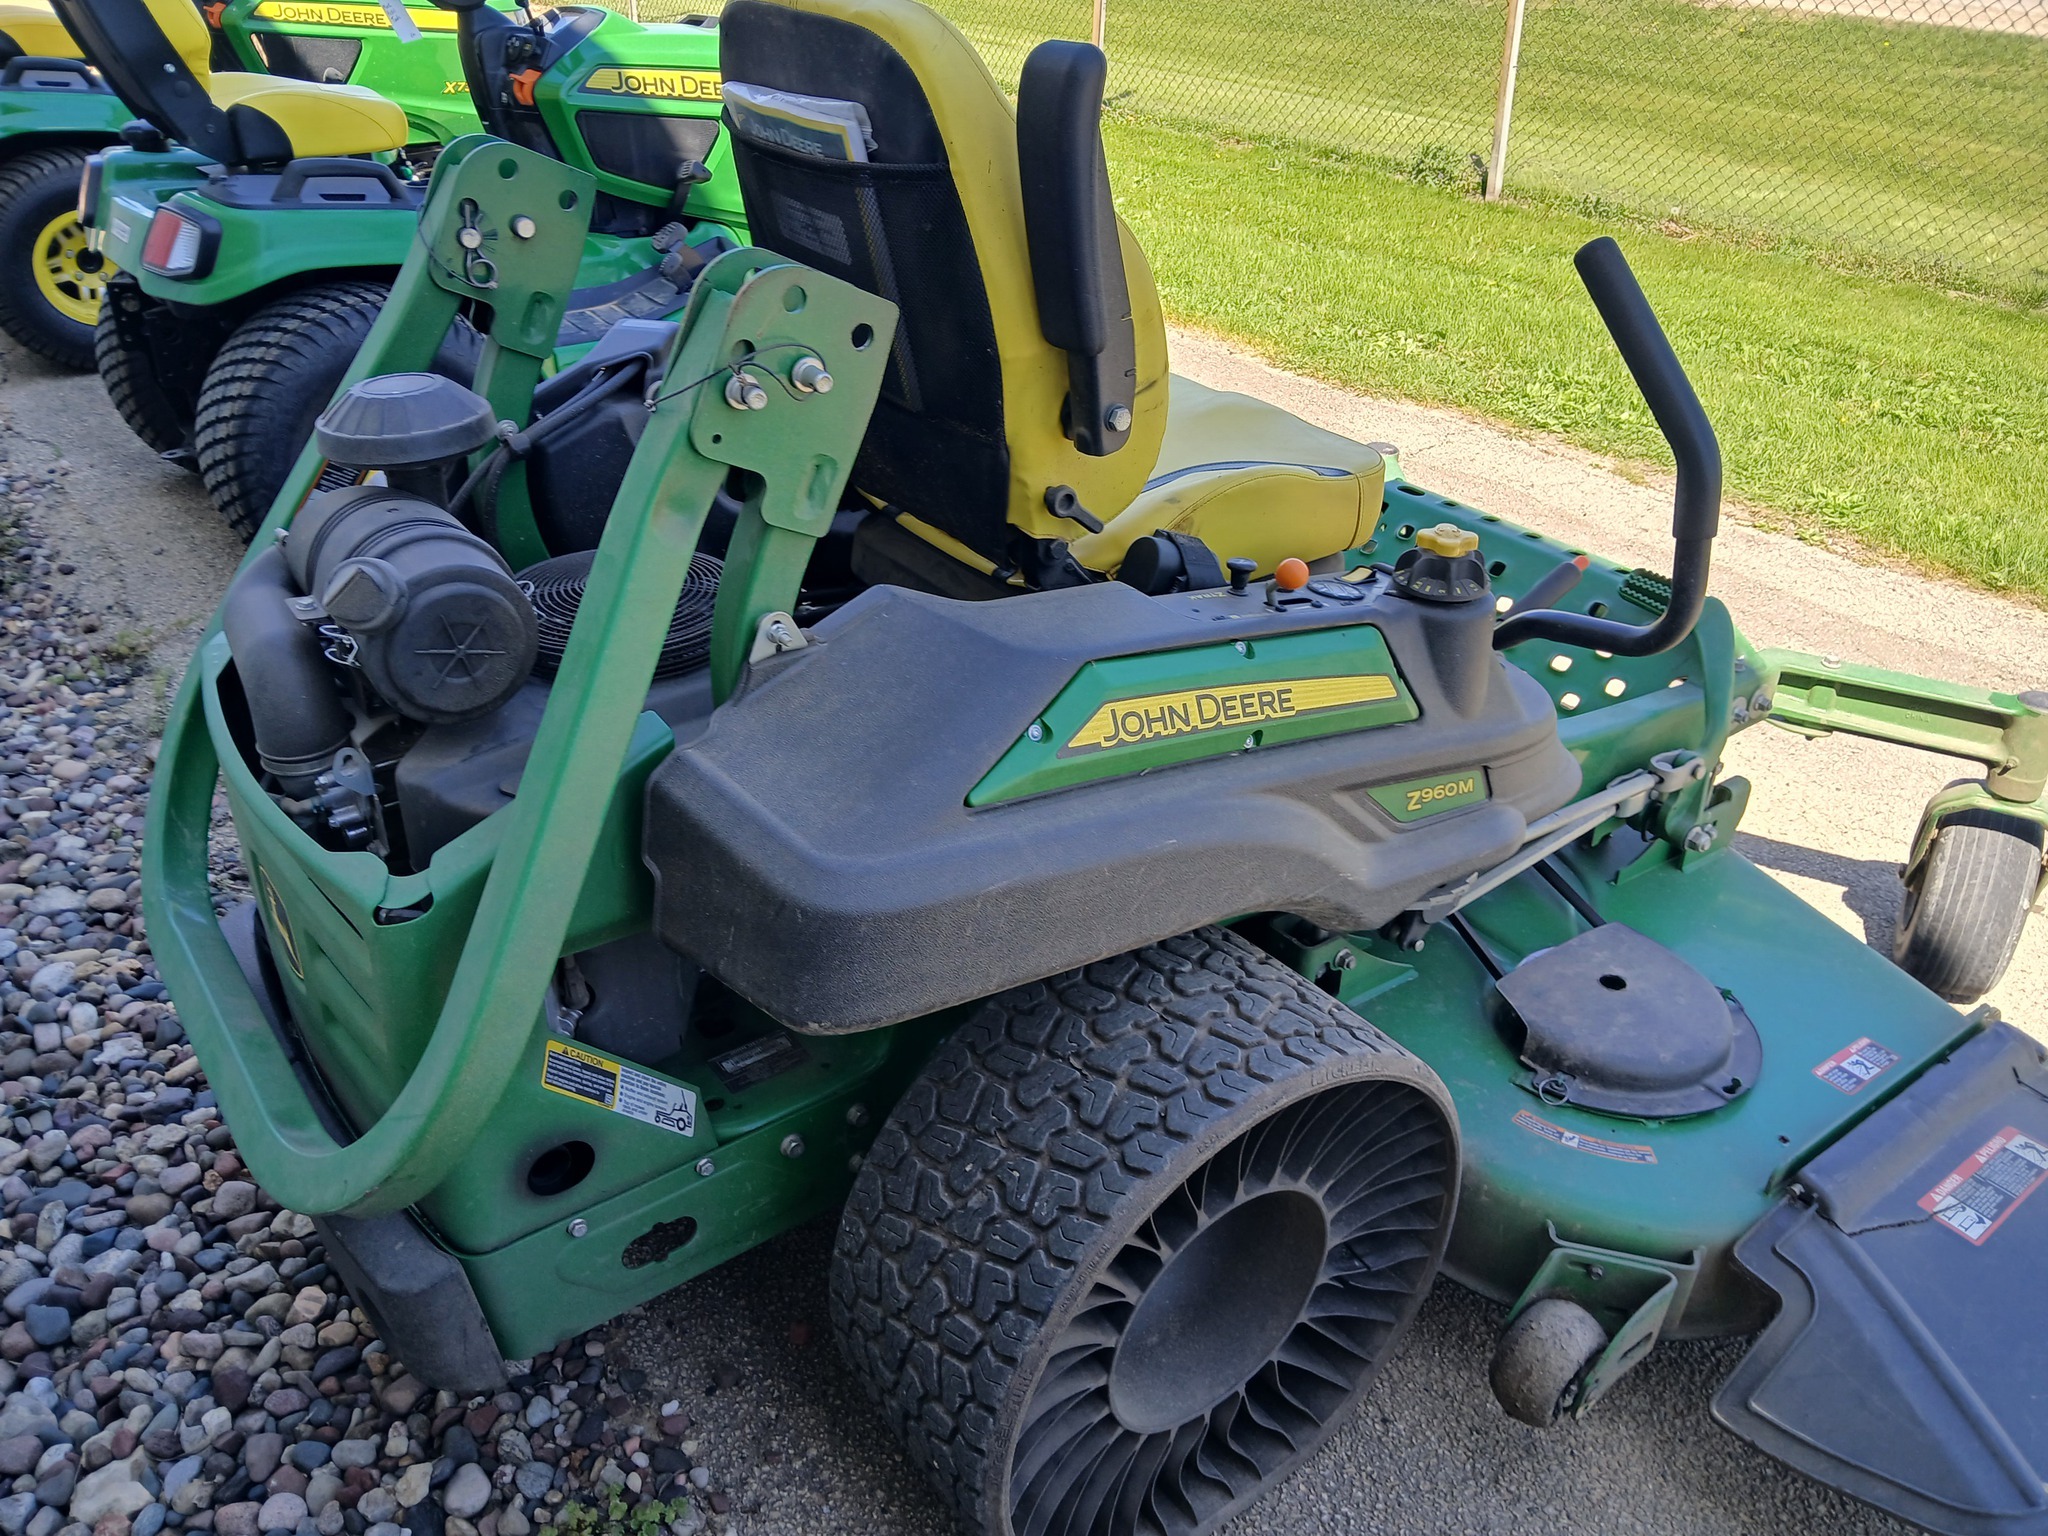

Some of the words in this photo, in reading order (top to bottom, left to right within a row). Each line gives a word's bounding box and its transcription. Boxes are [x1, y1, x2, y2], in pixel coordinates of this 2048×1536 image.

[273, 4, 323, 23] JOHN
[327, 7, 387, 25] DEERE
[612, 71, 676, 93] JOHN
[680, 75, 722, 96] DEE
[780, 126, 825, 159] DEERE
[1103, 703, 1190, 742] JOHN
[1195, 688, 1295, 724] DEERE
[1406, 778, 1474, 811] Z960M
[570, 1049, 604, 1067] CAUTION
[1935, 1173, 1964, 1197] DANGER
